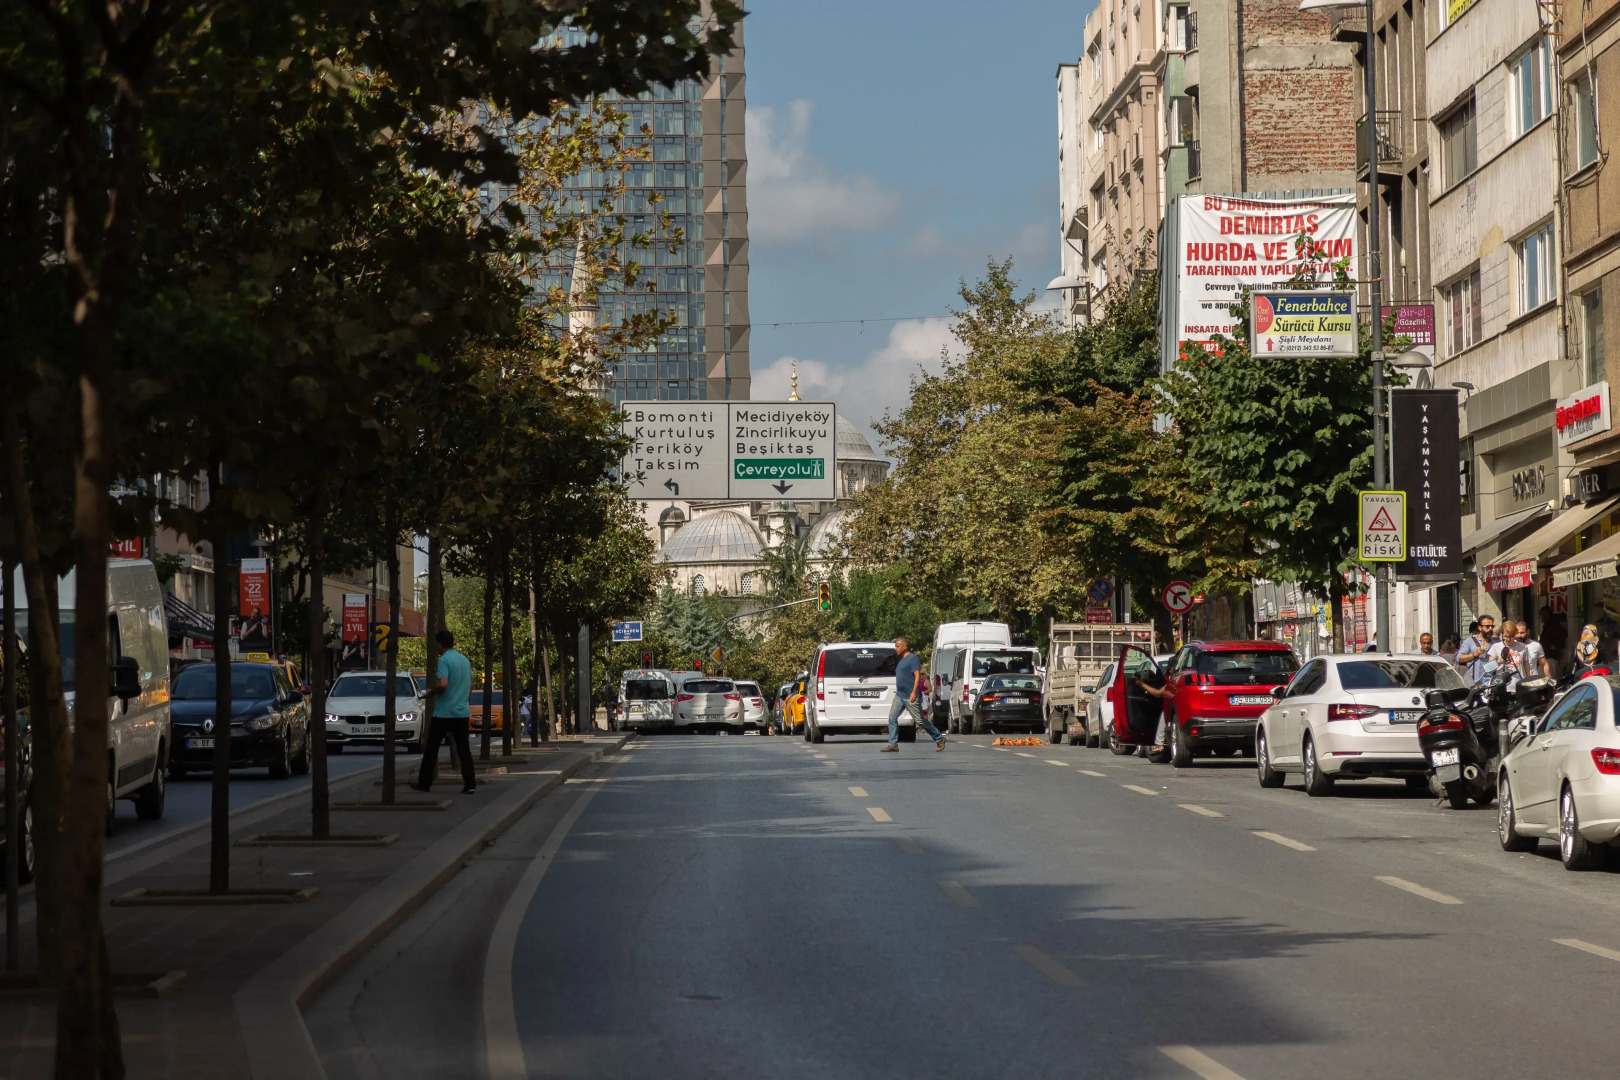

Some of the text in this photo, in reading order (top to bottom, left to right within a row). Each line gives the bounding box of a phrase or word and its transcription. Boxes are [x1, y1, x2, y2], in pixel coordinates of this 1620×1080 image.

[1203, 196, 1222, 211] BU
[1220, 212, 1319, 236] DEMİRTAŞ
[1186, 242, 1257, 262] HURDA
[1263, 242, 1288, 260] VE
[1185, 264, 1257, 276] TARAFINDAN
[1205, 282, 1236, 291] Çevreye
[1276, 297, 1348, 315] Fenerbahçe
[1273, 316, 1352, 332] Sürücü Kursu
[635, 410, 713, 422] Bomonti
[736, 410, 830, 425] Mecidiyeköy
[635, 426, 715, 439] Kurtuluş
[735, 426, 827, 441] Zincirlikuyu
[635, 442, 703, 457] Feriköy
[736, 442, 814, 455] Beşiktaş
[634, 458, 700, 470] Taksim
[736, 463, 811, 478] Çevreyolu
[1365, 534, 1401, 543] KAZA
[1364, 544, 1402, 555] RİSKİ
[1410, 546, 1416, 557] 6
[1571, 565, 1598, 582] YENER
[352, 623, 365, 632] YIL
[1395, 711, 1416, 721] 34 SF
